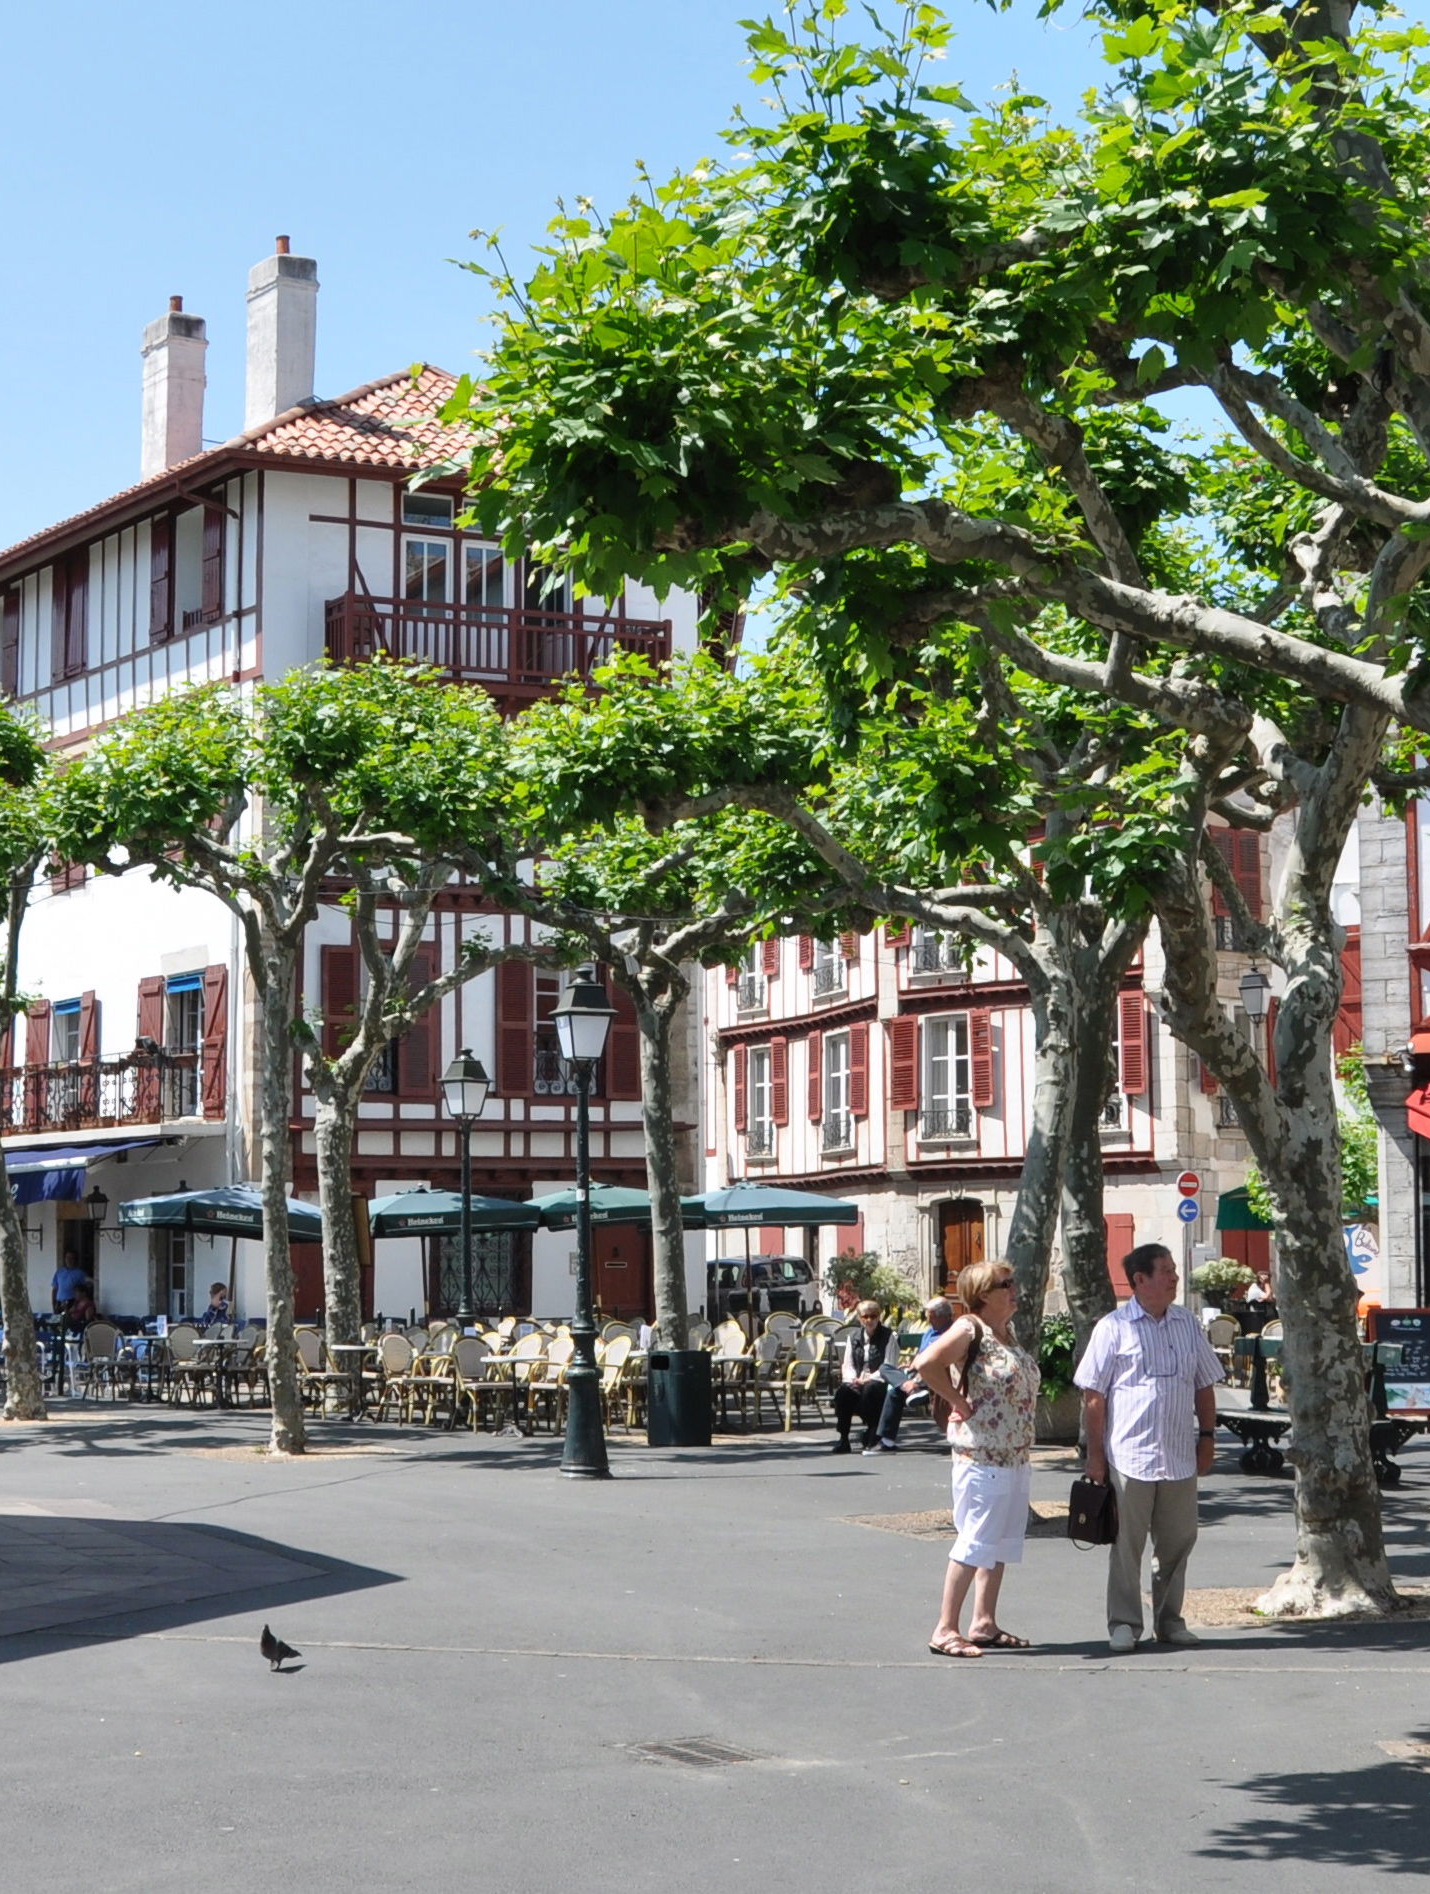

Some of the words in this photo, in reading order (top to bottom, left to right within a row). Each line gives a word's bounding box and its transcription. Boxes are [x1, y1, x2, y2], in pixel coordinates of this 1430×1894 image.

[216, 1210, 254, 1222] Heineken
[407, 1215, 444, 1226] Heineken
[728, 1212, 763, 1222] Heineken
